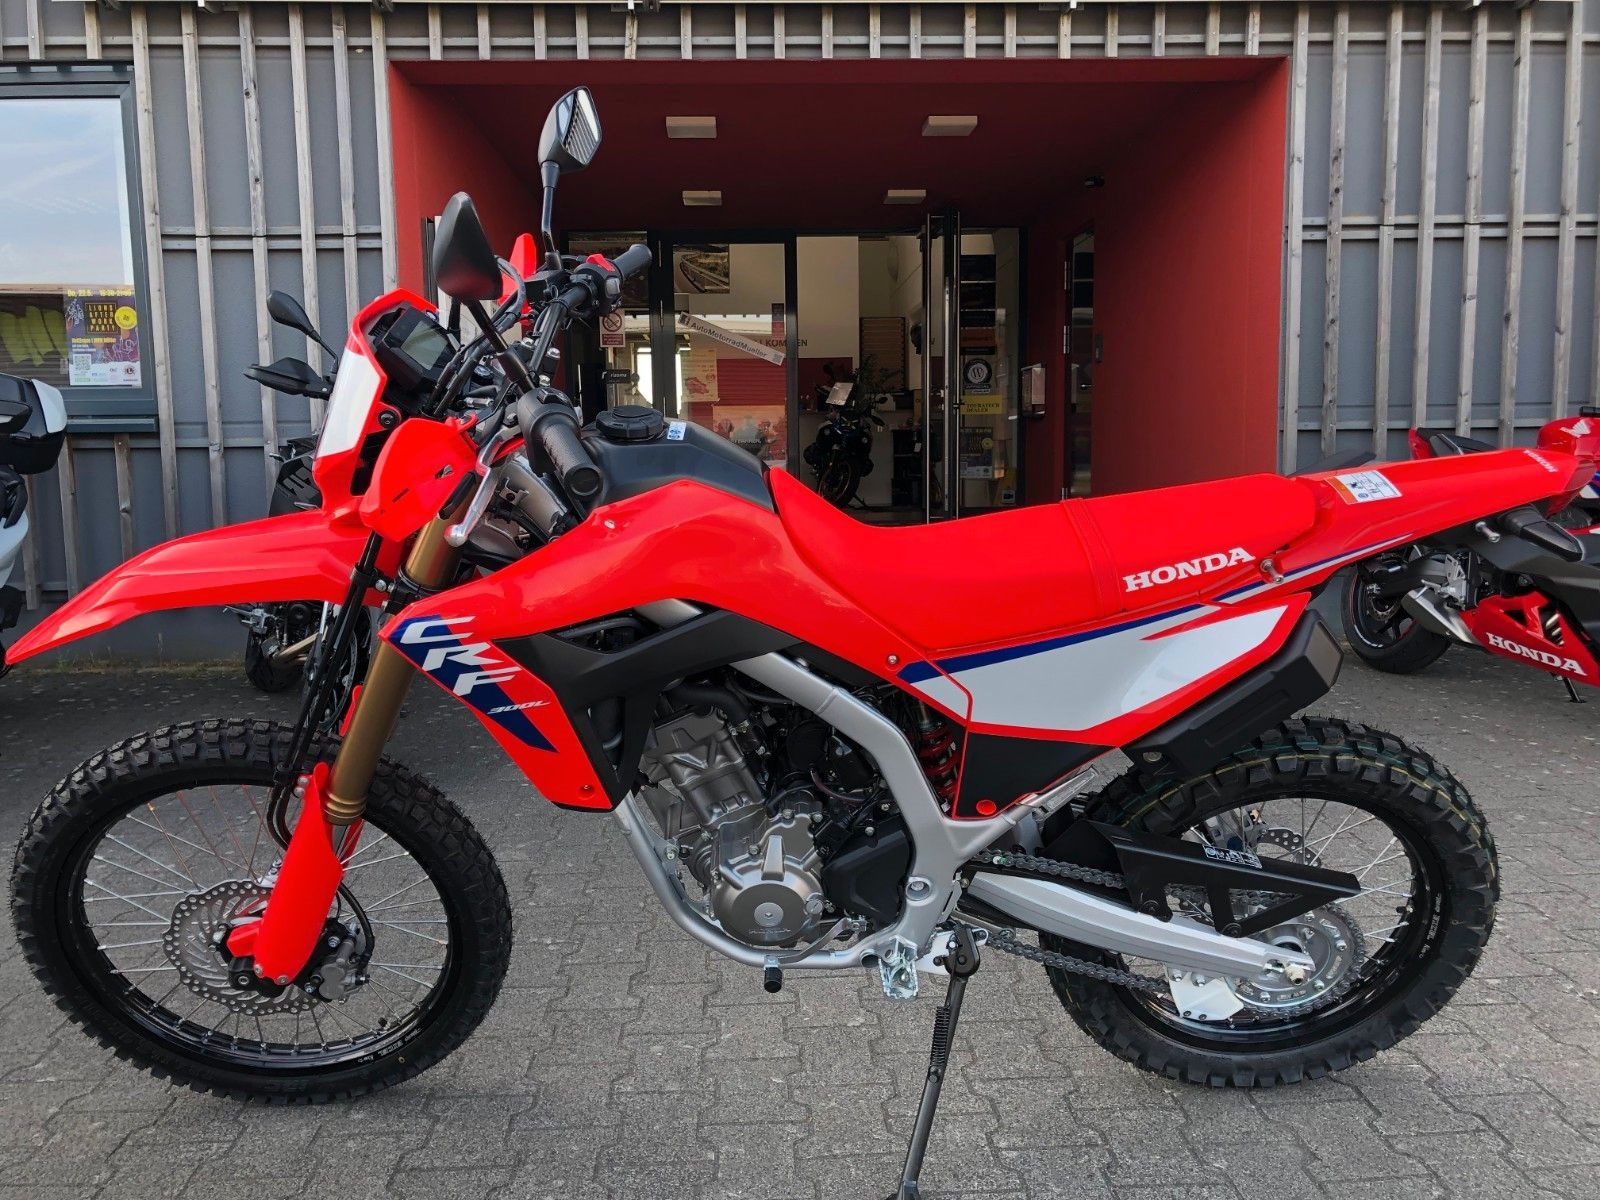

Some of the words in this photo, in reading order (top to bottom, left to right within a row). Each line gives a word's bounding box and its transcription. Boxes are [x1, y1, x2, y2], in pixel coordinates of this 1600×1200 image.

[691, 322, 768, 358] AutoMotorradMueller
[1123, 547, 1256, 592] HONDA
[400, 615, 522, 697] CRF
[1486, 632, 1588, 676] HONDA
[487, 700, 552, 715] 300L
